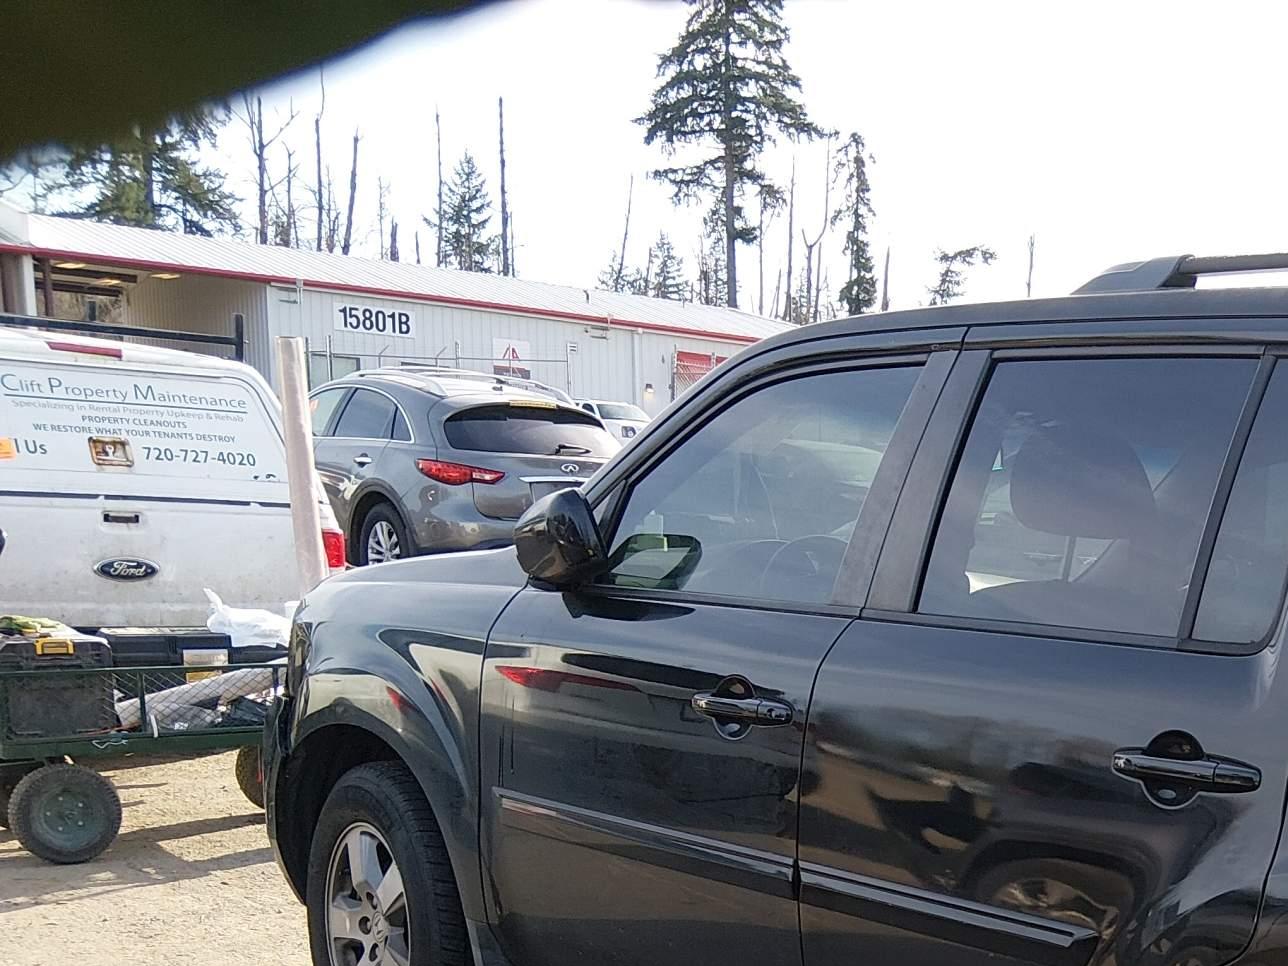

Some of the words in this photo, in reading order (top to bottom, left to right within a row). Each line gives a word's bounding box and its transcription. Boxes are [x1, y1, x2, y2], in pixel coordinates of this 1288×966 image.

[338, 305, 411, 335] 15801B
[0, 373, 44, 393] Clift
[47, 377, 128, 402] Property
[133, 383, 247, 409] Maintenance
[10, 399, 75, 412] Specializing
[88, 403, 121, 413] Rental
[122, 406, 165, 418] Property
[166, 409, 204, 421] Upkeep
[214, 412, 244, 423] Rehab
[81, 414, 130, 426] PROPERTY
[132, 417, 188, 429] CLEANOUTS
[32, 423, 50, 432] WE
[51, 425, 95, 434] RESTORE
[95, 427, 123, 436] WHAT
[125, 429, 151, 438] YOUR
[152, 431, 194, 441] TENANTS
[195, 434, 236, 443] DESTROY
[24, 439, 48, 455] Us
[142, 446, 257, 467] 720-727-4020
[110, 561, 147, 577] Ford
